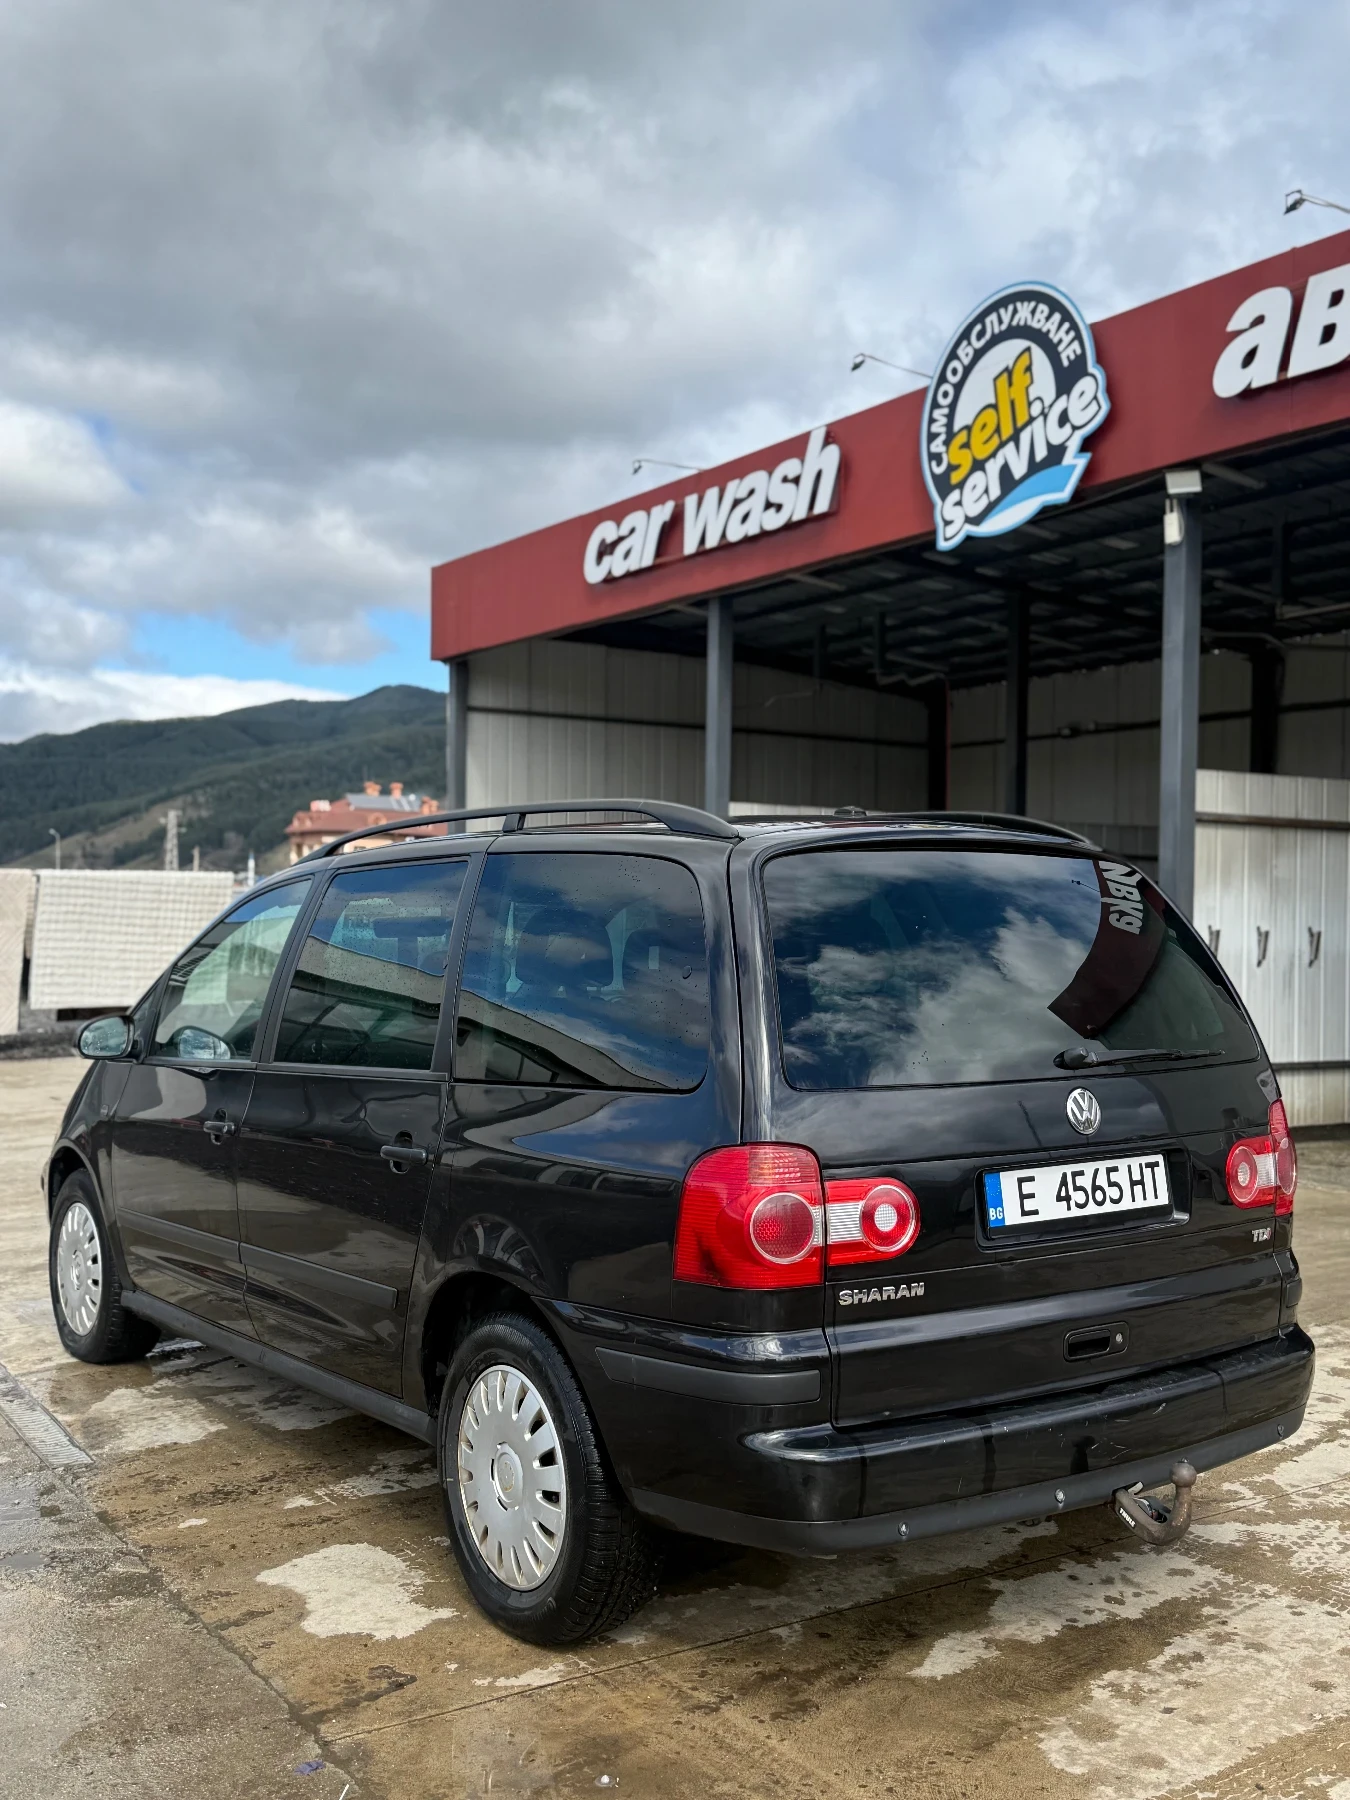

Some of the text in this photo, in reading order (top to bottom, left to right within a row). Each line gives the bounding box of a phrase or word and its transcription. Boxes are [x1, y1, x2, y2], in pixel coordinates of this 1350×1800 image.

[930, 301, 1082, 475] САМООБСЛУЖВАНЕ
[948, 347, 1032, 485] self
[942, 375, 1099, 540] service
[583, 425, 840, 585] car wash
[989, 1207, 1003, 1221] BG
[1017, 1176, 1039, 1217] E
[1056, 1166, 1123, 1211] 4565
[838, 1282, 925, 1307] SHARAN
[1119, 1507, 1136, 1528] THULE
